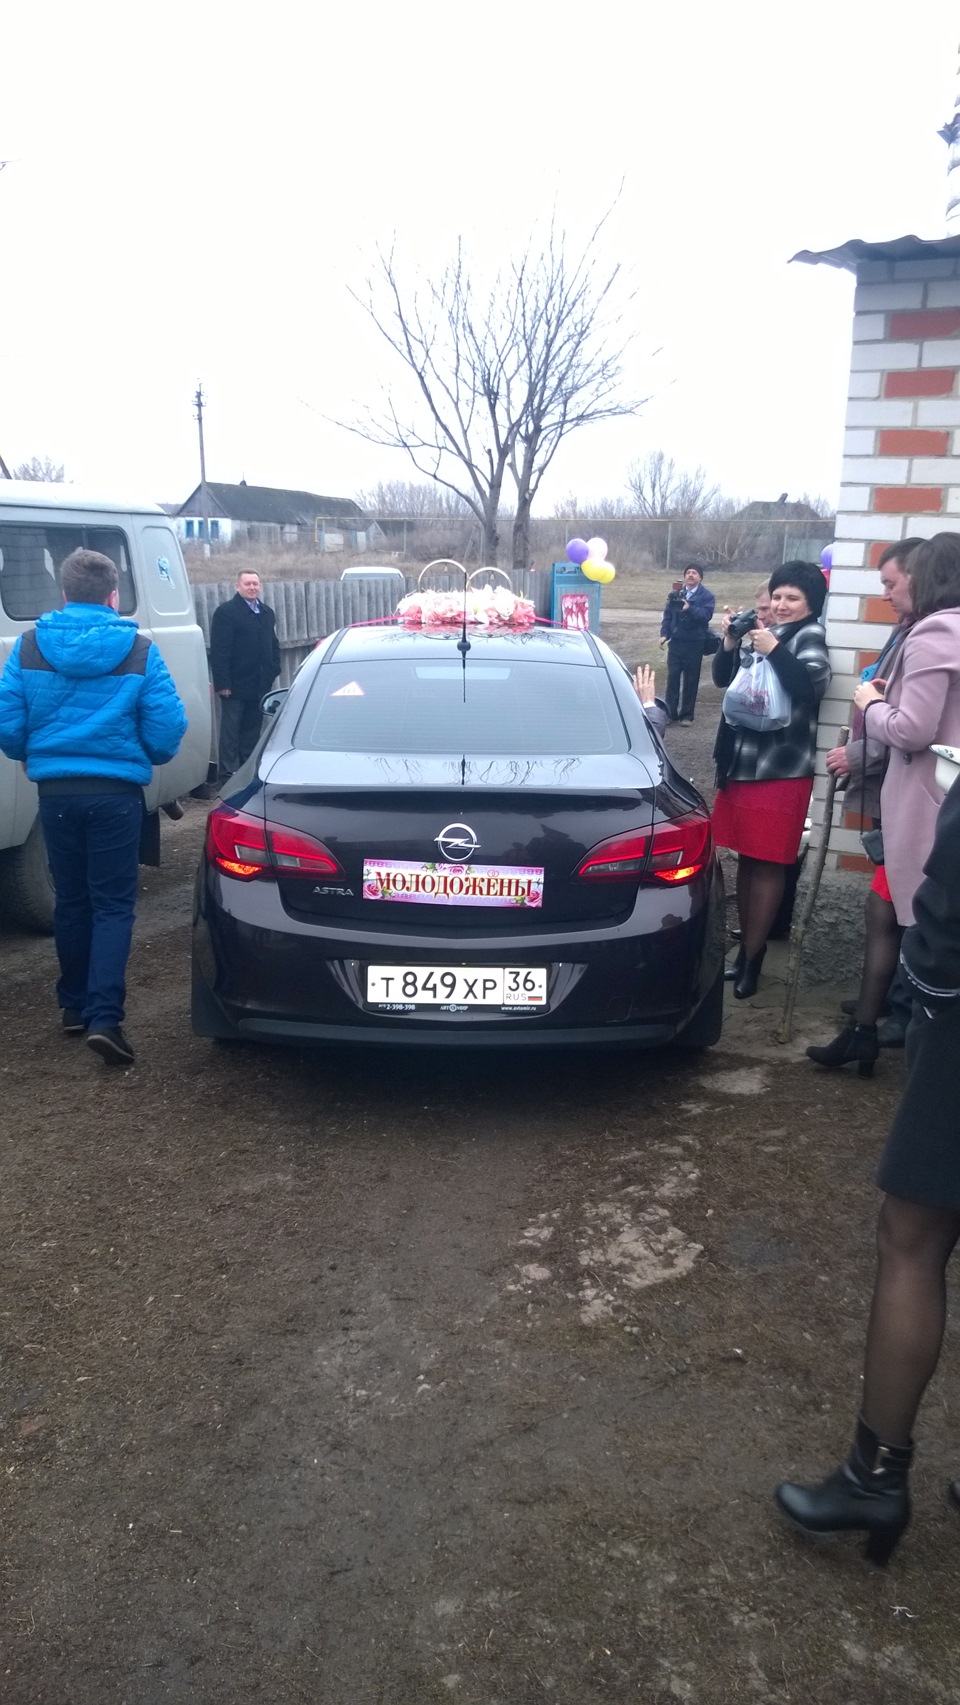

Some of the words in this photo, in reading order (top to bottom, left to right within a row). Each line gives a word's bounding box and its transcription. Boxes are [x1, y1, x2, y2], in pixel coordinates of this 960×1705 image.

[312, 886, 354, 896] ASTRA
[374, 871, 533, 898] МОЛОДОЖЕНЫ
[507, 971, 536, 991] 36
[506, 993, 527, 1001] RUS
